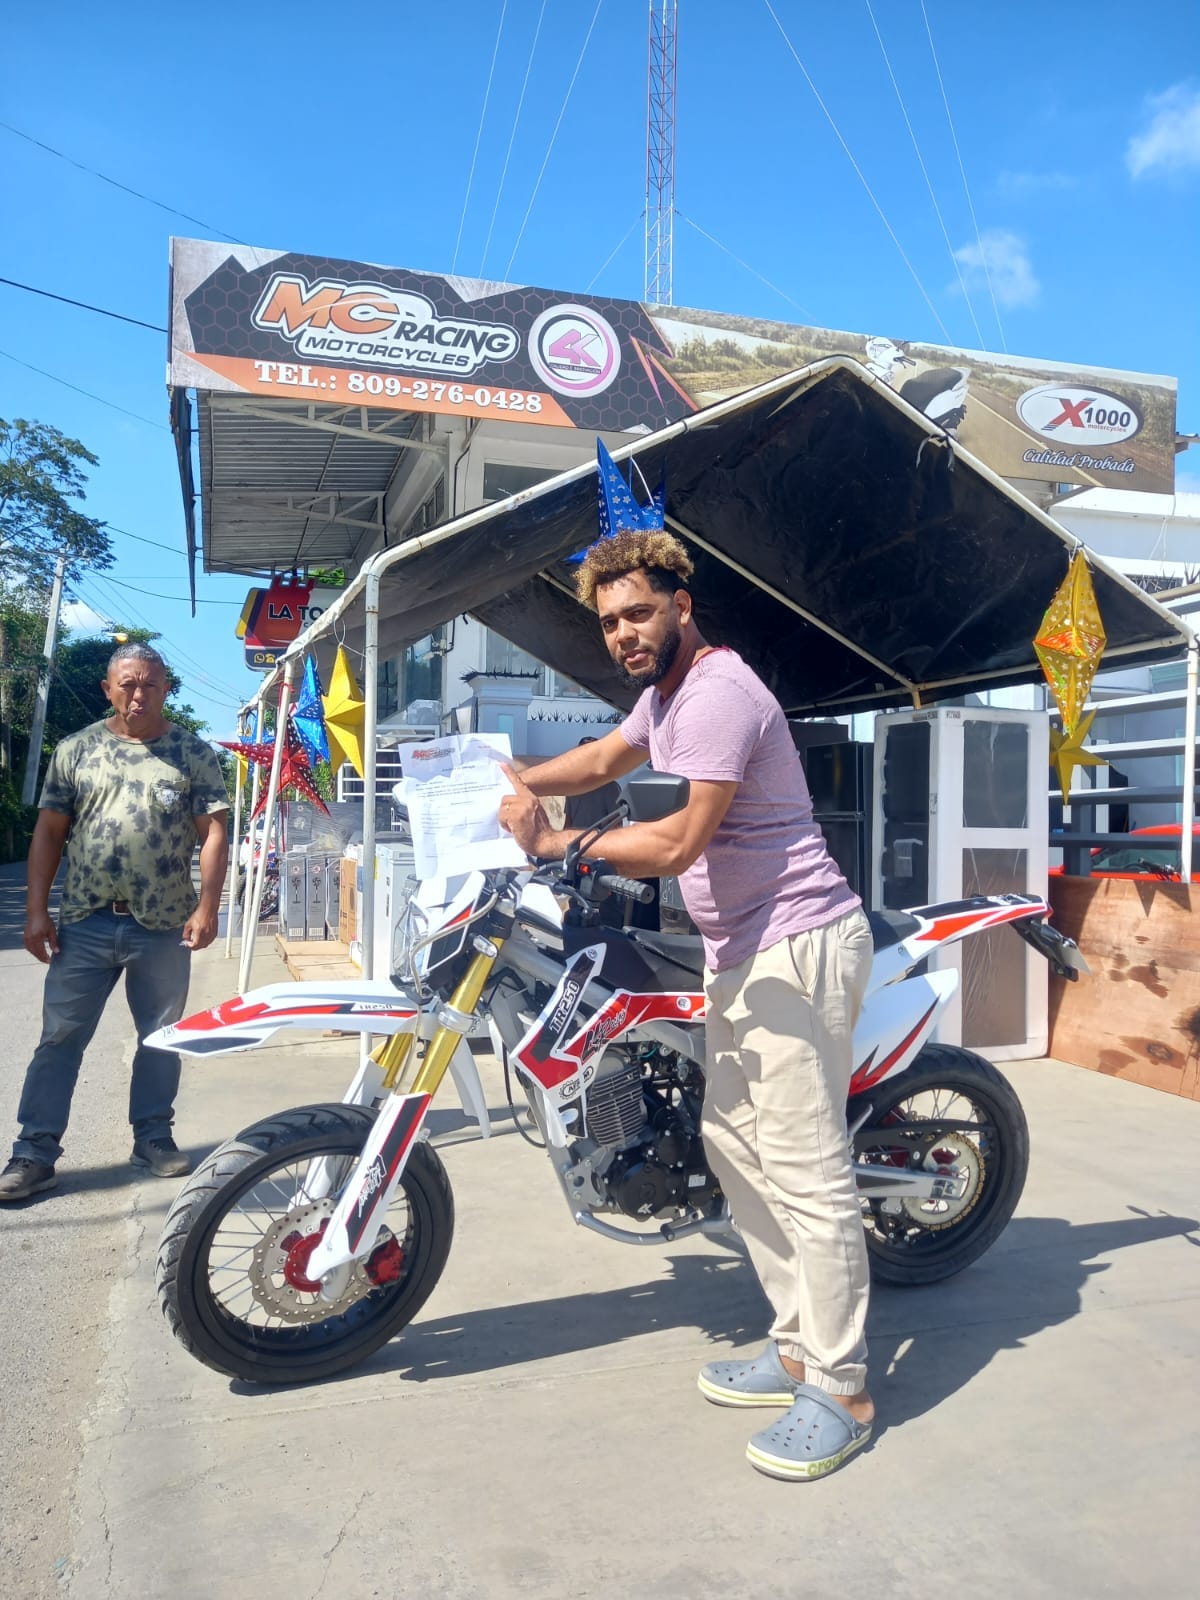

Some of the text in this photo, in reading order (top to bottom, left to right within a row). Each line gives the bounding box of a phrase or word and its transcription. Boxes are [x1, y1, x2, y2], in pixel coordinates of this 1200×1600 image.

[260, 281, 510, 357] MC RACING
[305, 336, 470, 367] MOTORCYCLES
[254, 360, 542, 413] TEL.: 809-276-0428
[1046, 397, 1131, 429] X1000
[1088, 423, 1126, 433] motorcycles
[1023, 448, 1135, 474] Calidad Probada
[269, 603, 293, 620] LA
